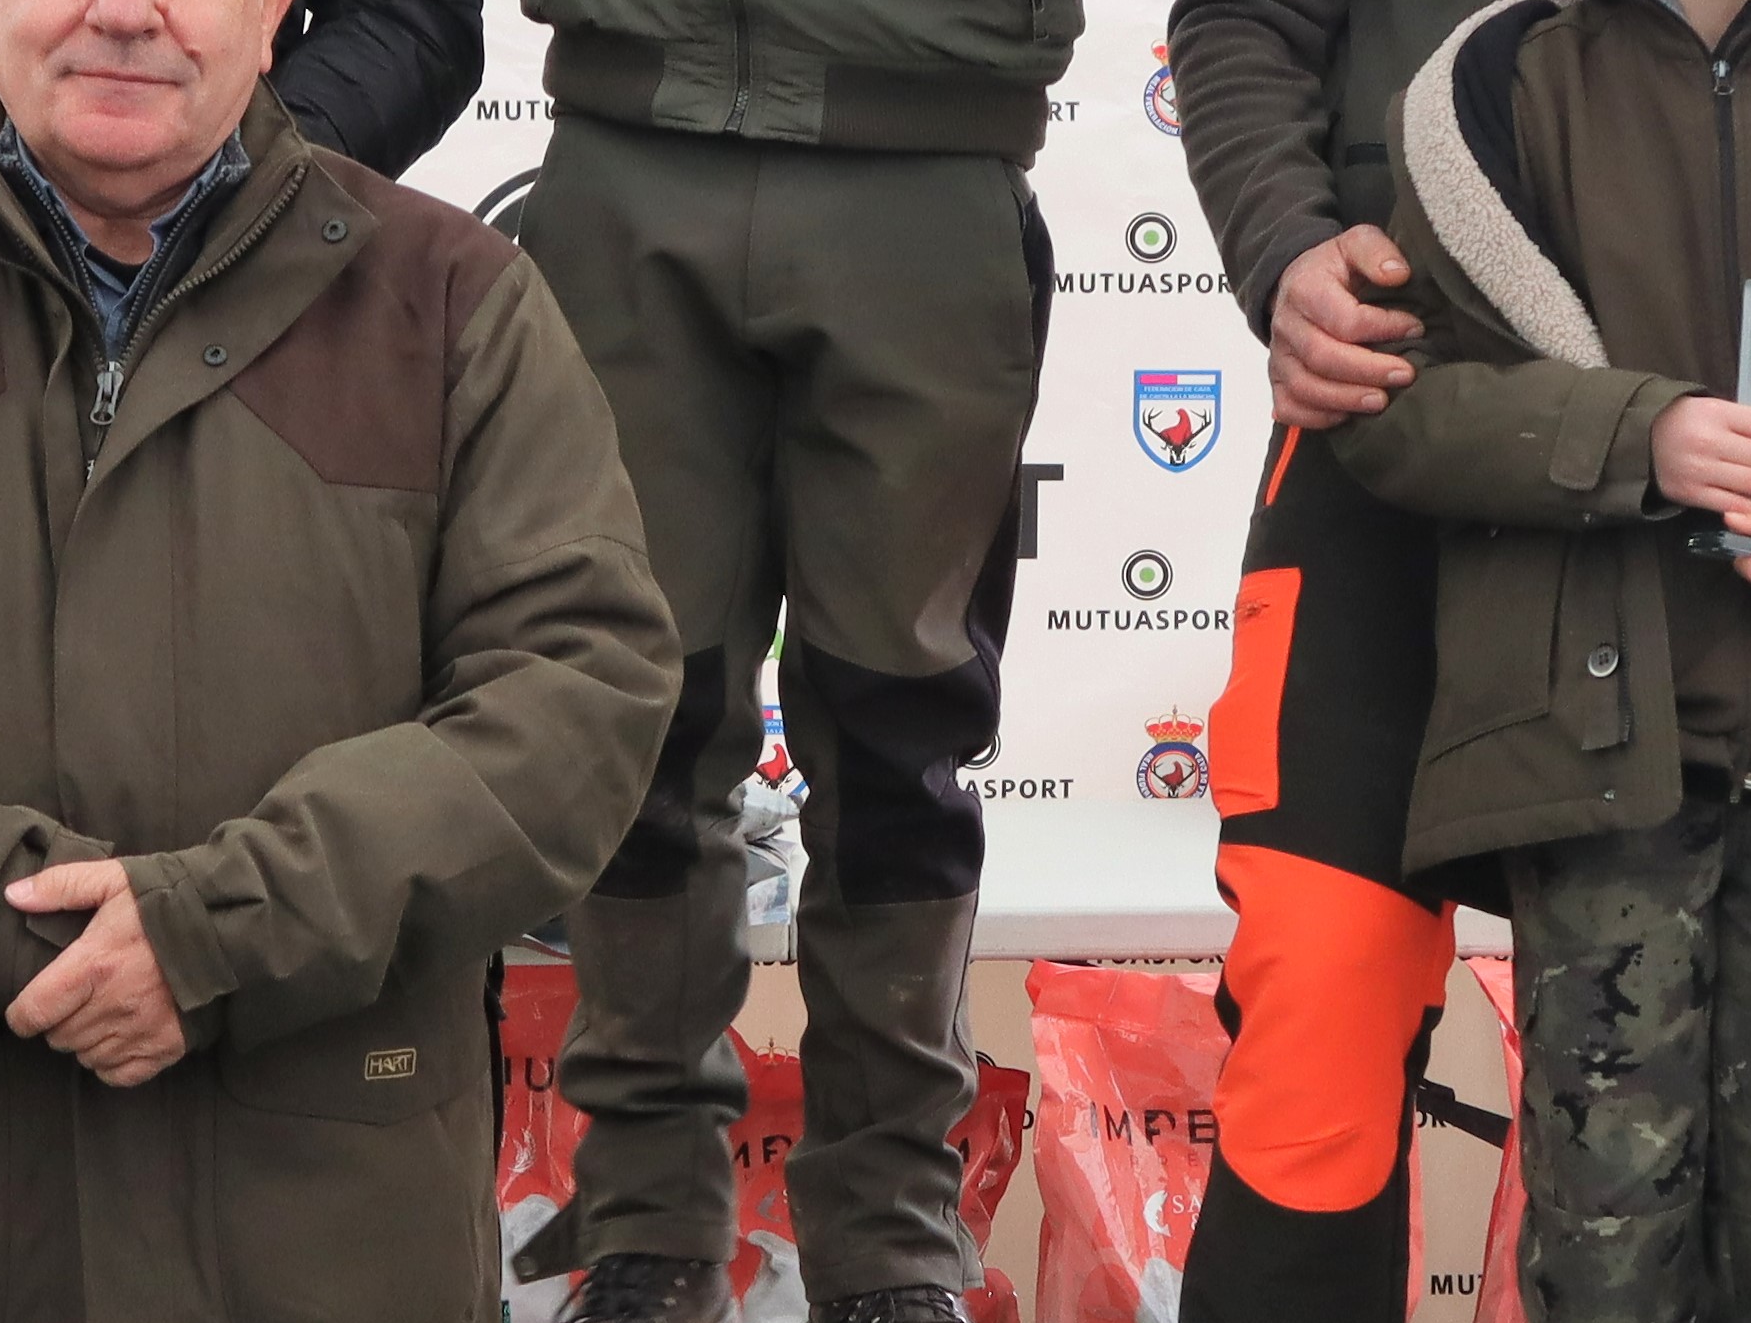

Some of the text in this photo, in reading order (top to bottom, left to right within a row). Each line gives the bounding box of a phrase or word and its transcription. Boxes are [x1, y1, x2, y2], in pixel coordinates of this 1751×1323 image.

[1054, 273, 1232, 294] MUTUASPOR
[1048, 610, 1234, 631] MUTUASPOR
[965, 779, 1074, 799] ASPORT
[369, 1054, 412, 1074] HART
[1088, 1102, 1215, 1145] IMPE
